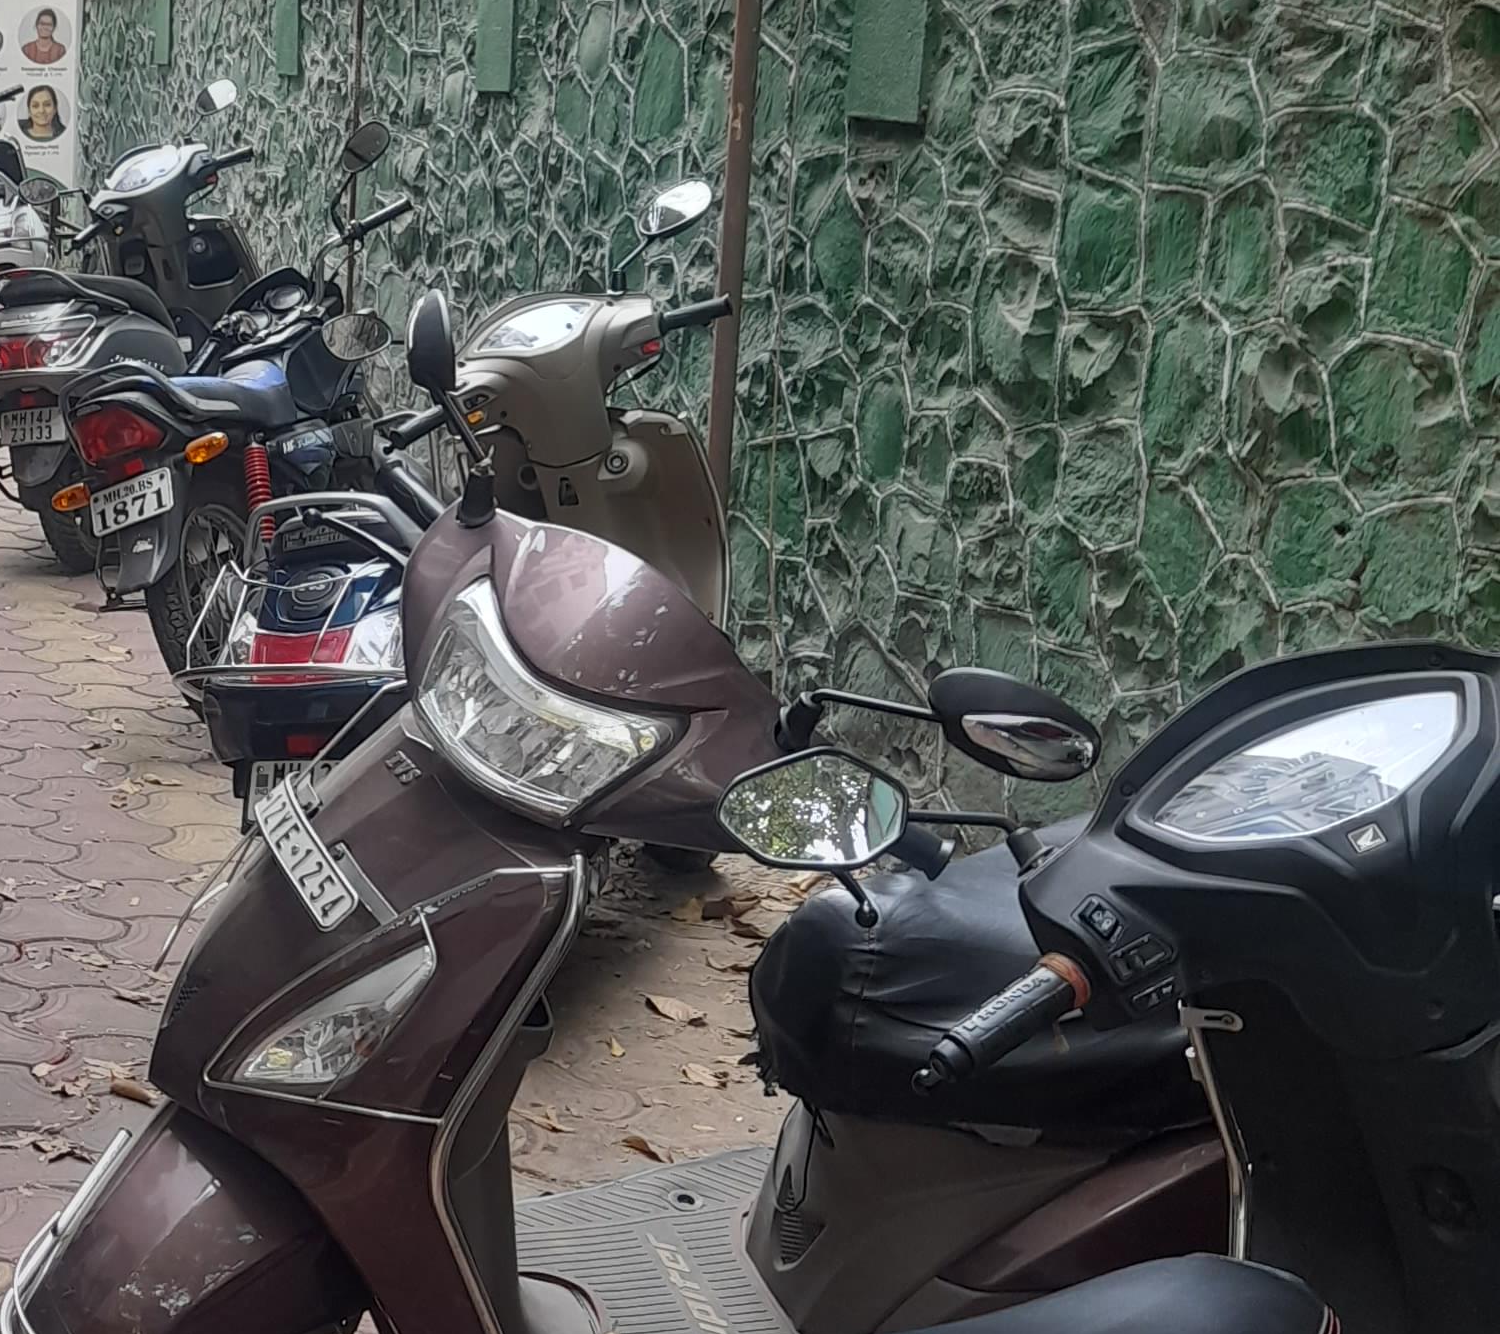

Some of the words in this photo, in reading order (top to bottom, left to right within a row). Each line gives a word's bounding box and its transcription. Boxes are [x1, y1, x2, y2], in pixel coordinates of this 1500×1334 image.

[11, 409, 52, 426] MH14J
[97, 487, 167, 531] 1871
[291, 848, 345, 920] 1254
